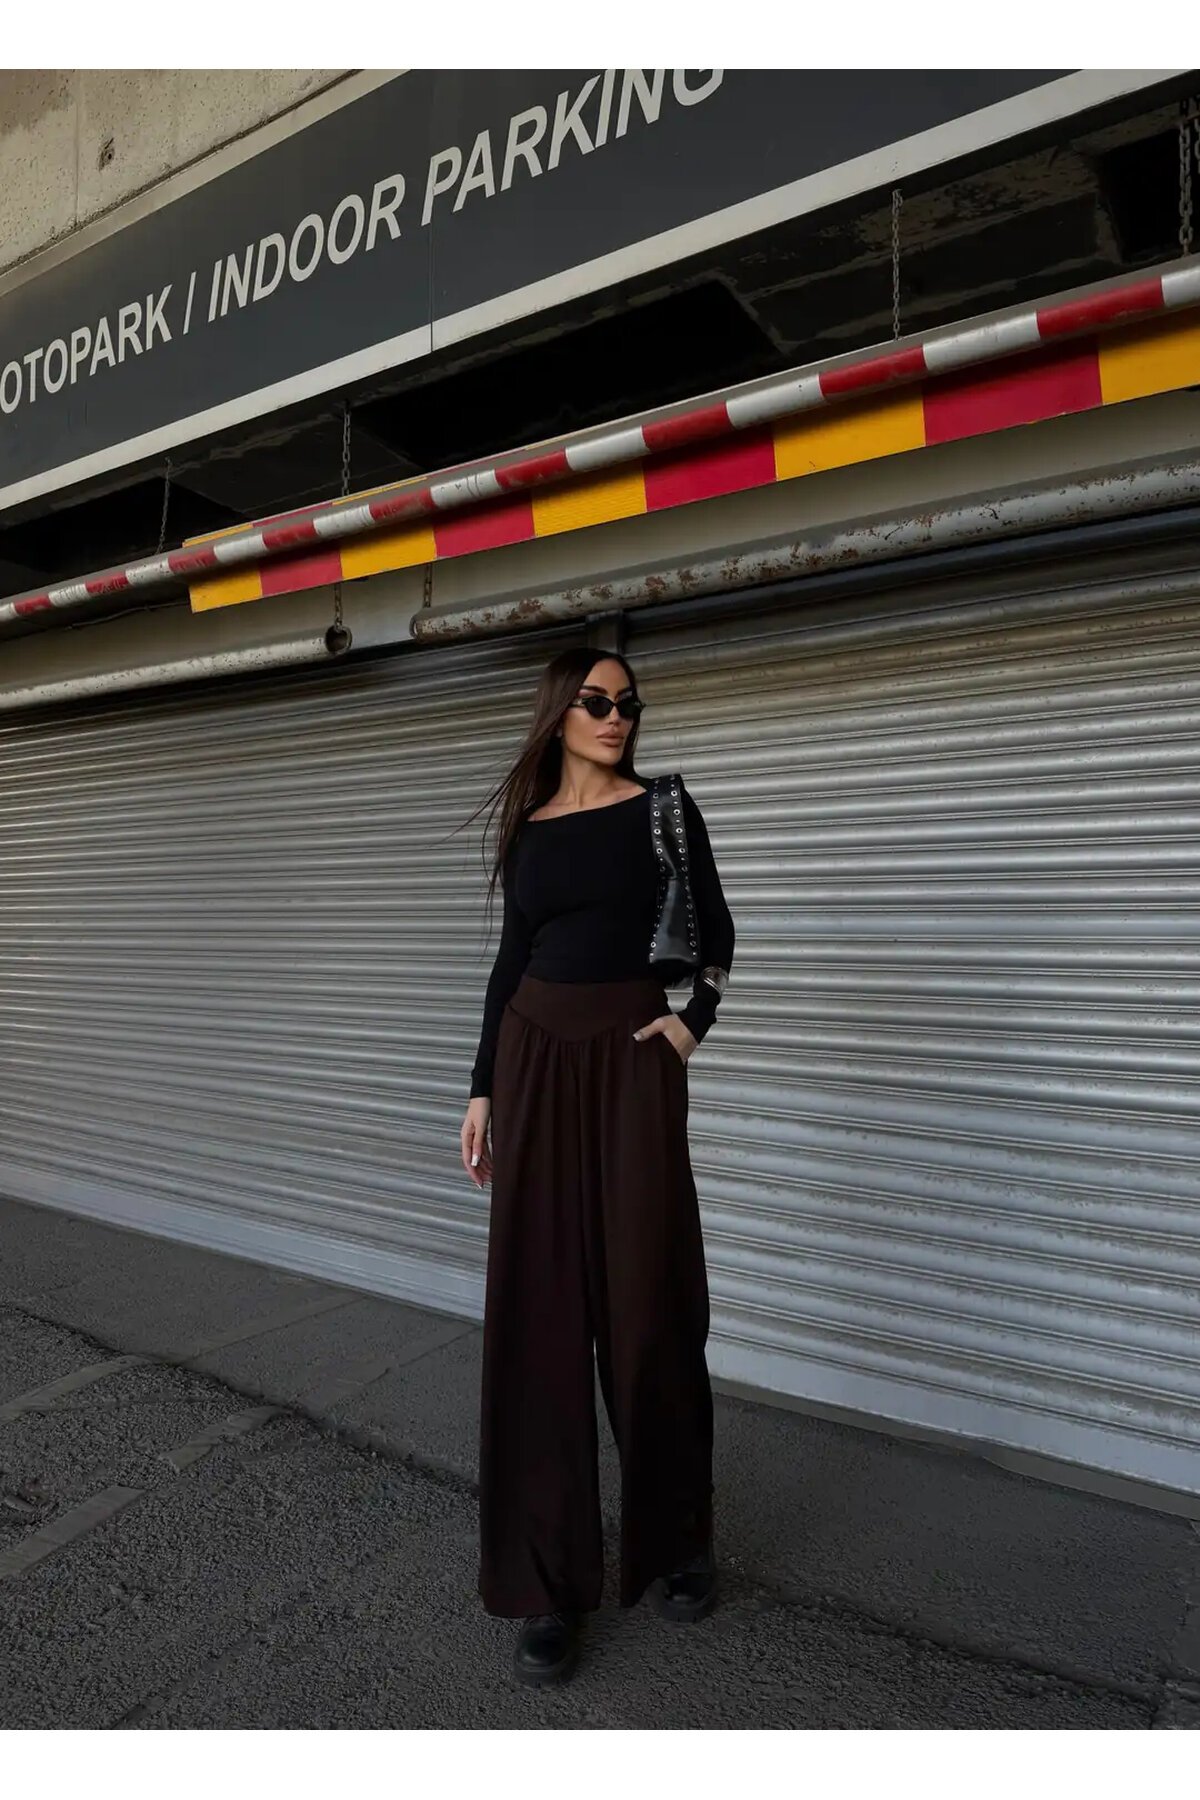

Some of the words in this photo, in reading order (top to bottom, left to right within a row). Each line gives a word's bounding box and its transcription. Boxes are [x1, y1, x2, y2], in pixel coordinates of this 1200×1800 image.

[0, 284, 173, 414] OTOPARK
[183, 271, 197, 335] /
[208, 173, 406, 323] INDOOR
